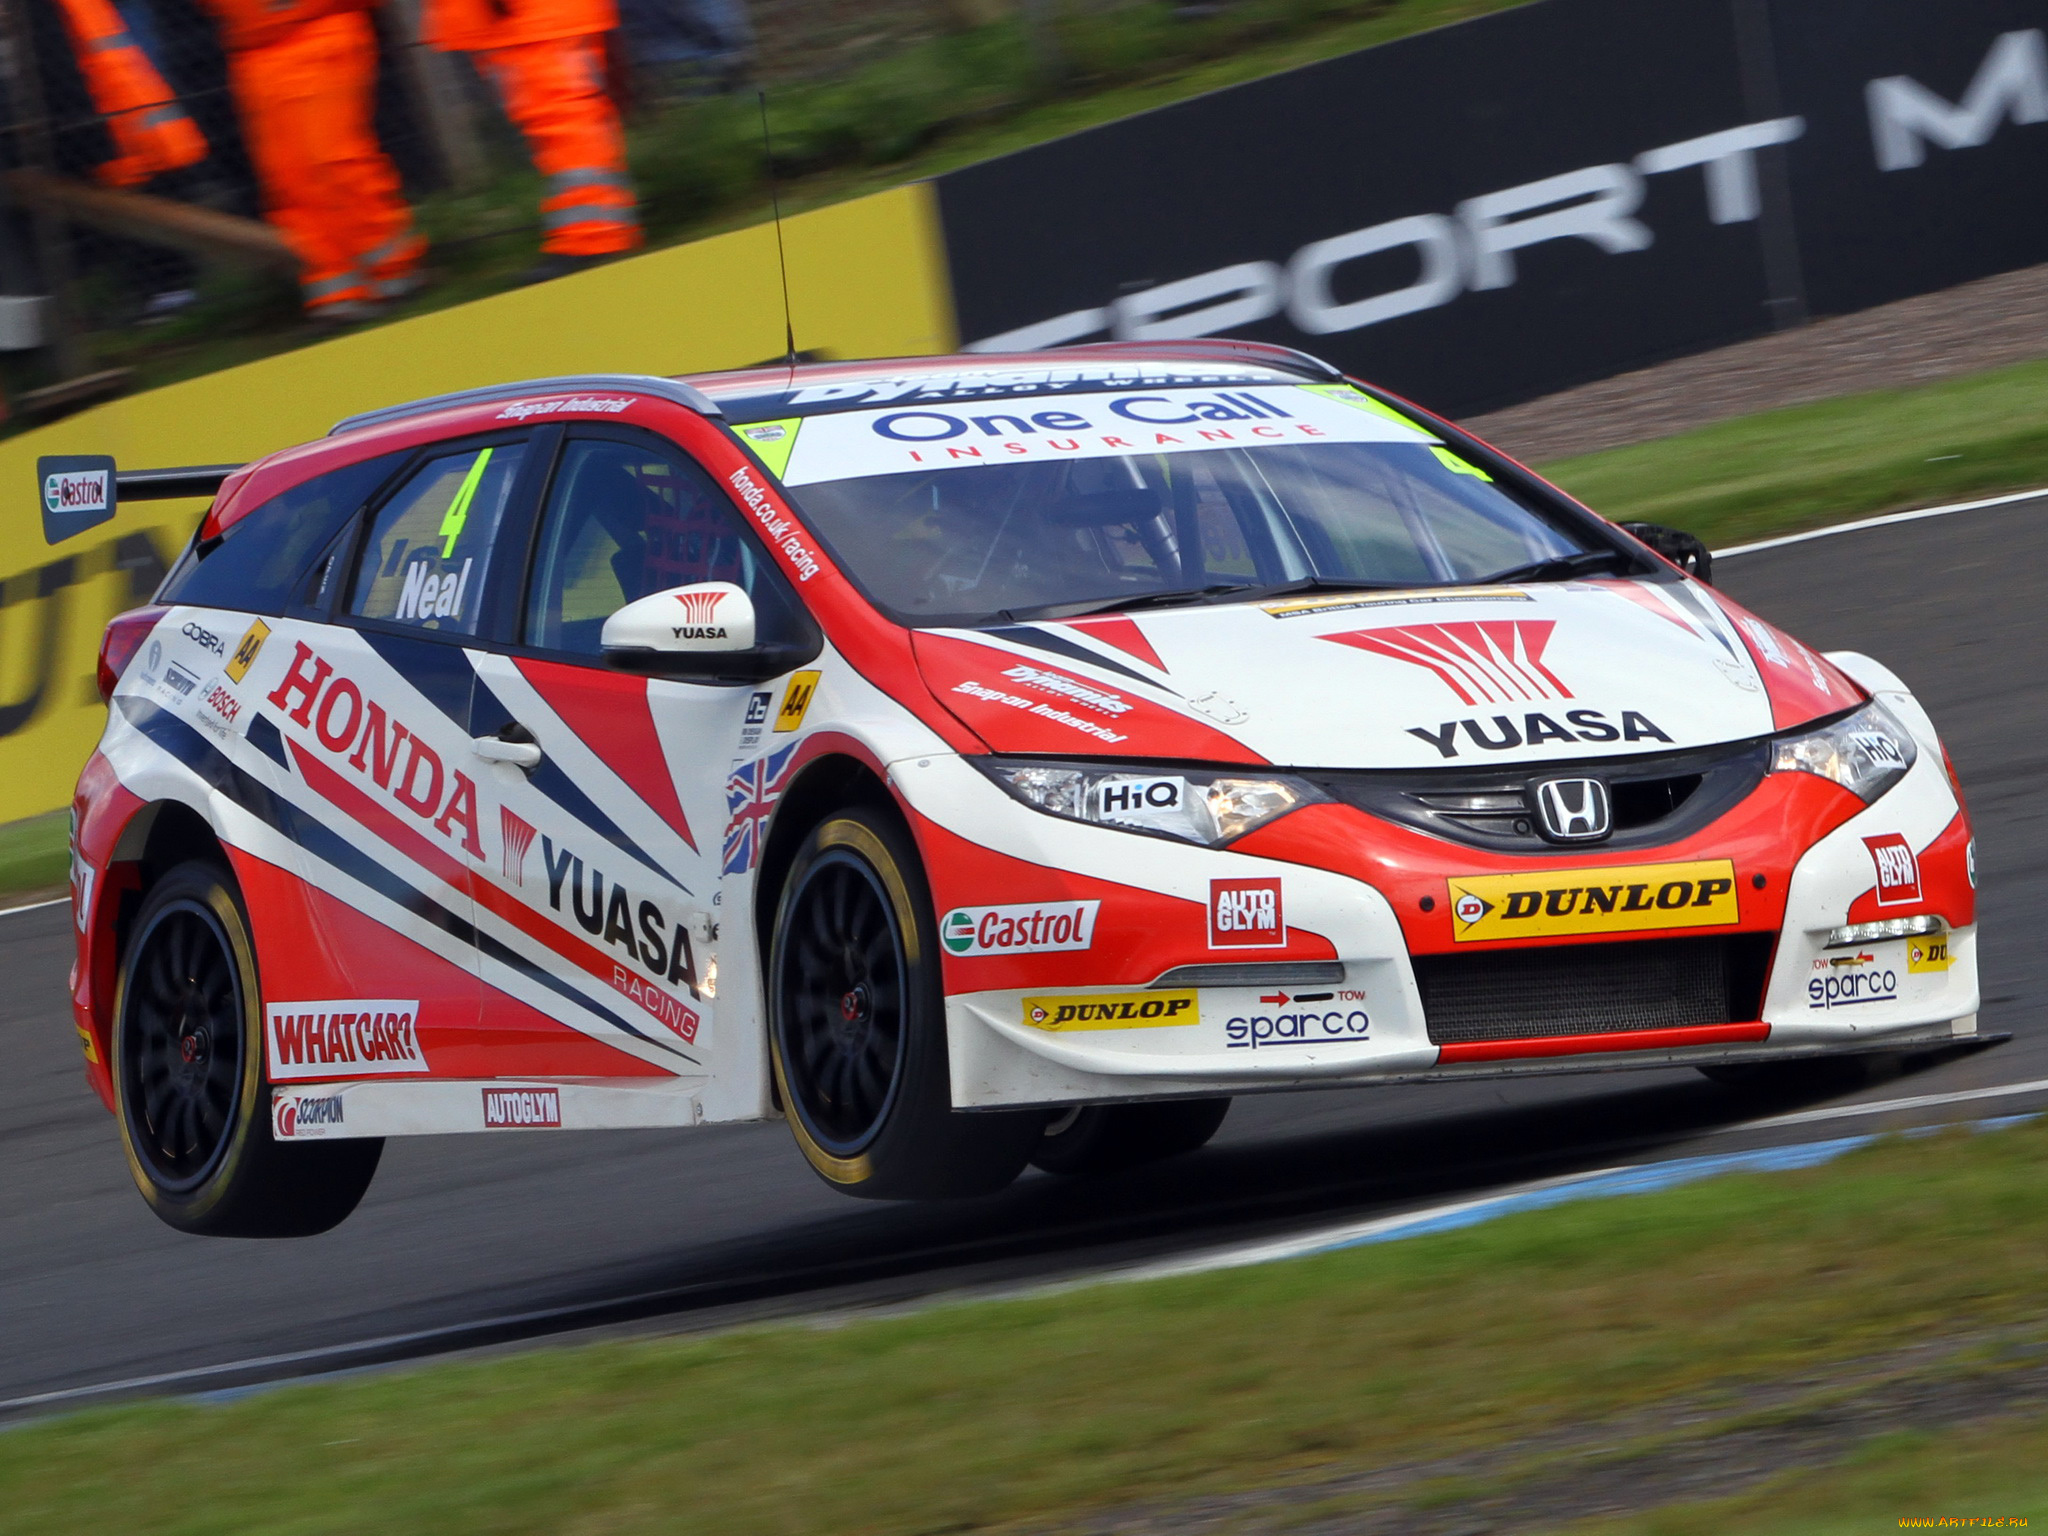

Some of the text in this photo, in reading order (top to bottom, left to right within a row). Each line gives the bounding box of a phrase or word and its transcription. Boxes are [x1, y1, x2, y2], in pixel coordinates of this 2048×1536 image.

[968, 116, 1804, 352] PORT
[872, 391, 1296, 443] One Call
[908, 424, 1326, 463] INSURANCE
[61, 475, 104, 507] Castrol
[439, 448, 494, 559] 4
[729, 466, 820, 582] honda.co.uk/racing
[395, 557, 473, 619] Neal
[182, 622, 225, 658] COBRA
[672, 627, 727, 639] YUASA
[207, 685, 242, 724] BOSCH
[1001, 663, 1134, 713] Dynamics
[951, 681, 1128, 744] Snap-on Industrial
[267, 640, 486, 862] HONDA
[1405, 710, 1676, 758] YUASA
[1855, 736, 1904, 764] HiQ
[1103, 781, 1179, 813] HiQ
[1875, 844, 1911, 869] AUTO
[1880, 863, 1914, 888] GLYM
[541, 833, 701, 1002] YUASA
[1217, 888, 1275, 910] AUTO
[1501, 878, 1732, 920] DUNLOP
[978, 909, 1084, 948] Castrol
[1216, 908, 1276, 932] GLYM
[613, 966, 697, 1040] RACING
[1337, 991, 1366, 1001] TOW
[1808, 970, 1896, 1010] sparco
[1053, 999, 1191, 1023] DUNLOP
[1226, 1011, 1369, 1049] sparco
[273, 1012, 417, 1065] WHATCAR?
[297, 1095, 344, 1124] SCORPION
[487, 1091, 558, 1124] AUTOGLYM
